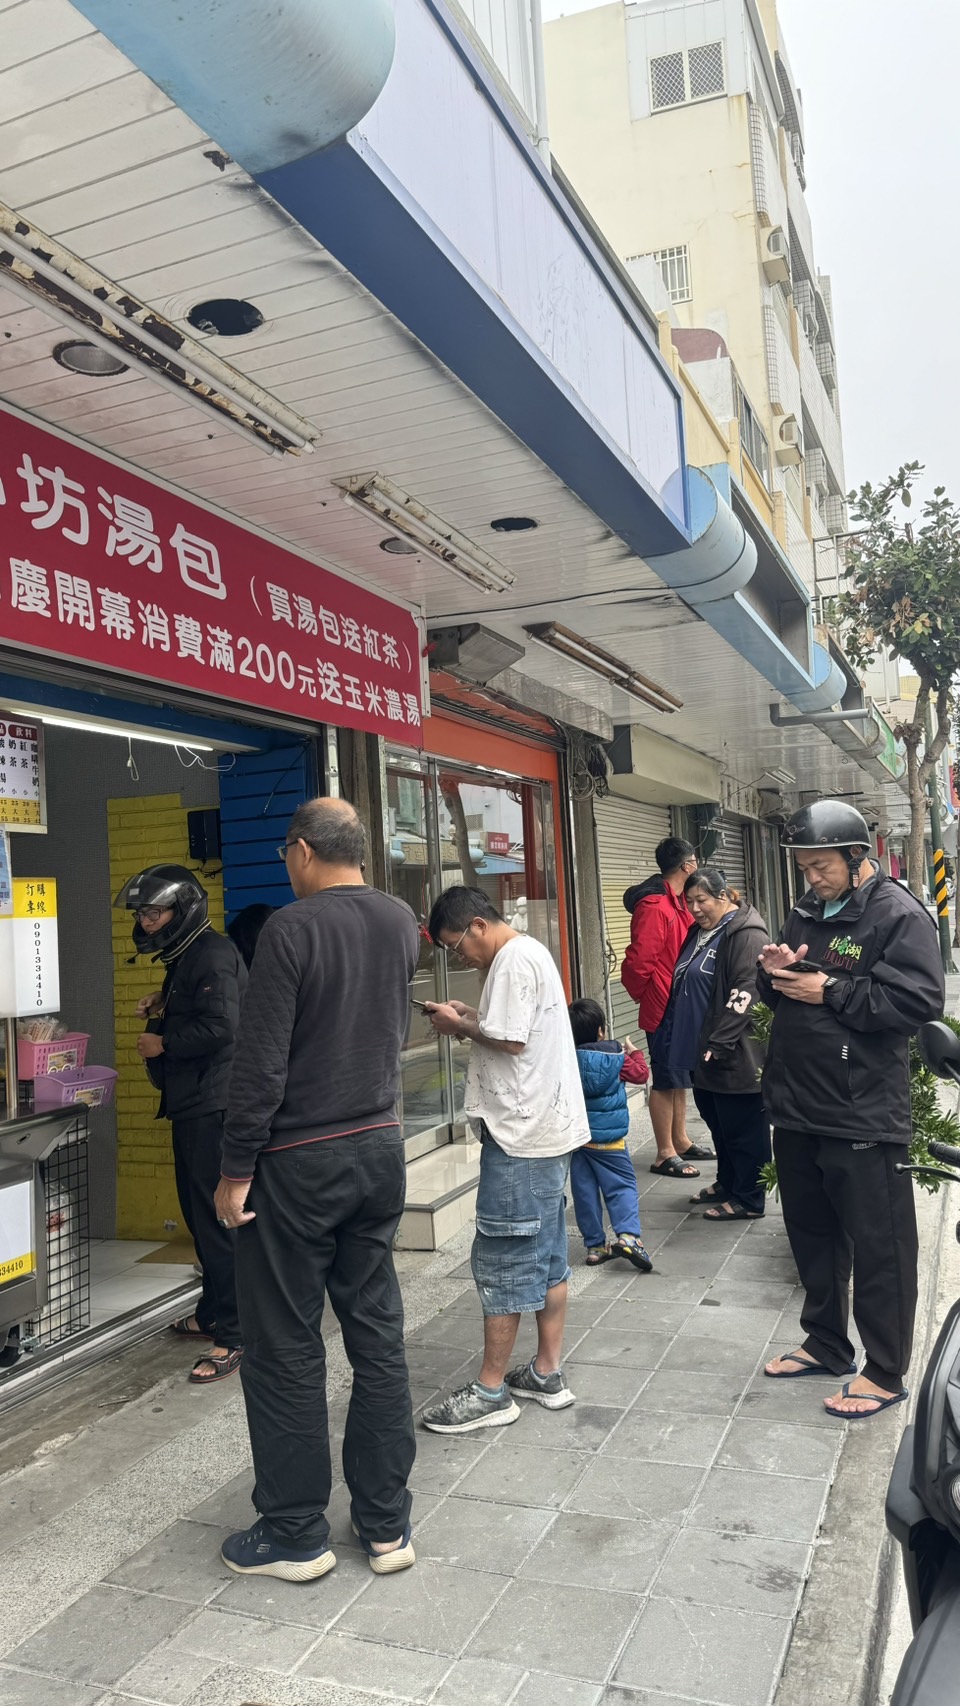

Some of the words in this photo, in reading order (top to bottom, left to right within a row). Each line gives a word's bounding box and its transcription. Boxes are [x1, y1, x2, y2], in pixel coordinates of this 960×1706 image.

[0, 453, 227, 600] 坊湯包
[9, 557, 421, 727] 慶開幕消費滿200元送玉米濃湯
[9, 739, 17, 767] 奶茶
[20, 741, 28, 768] 紅茶
[33, 922, 43, 1007] 0901334410
[726, 989, 752, 1014] 23
[0, 1260, 24, 1276] 34410
